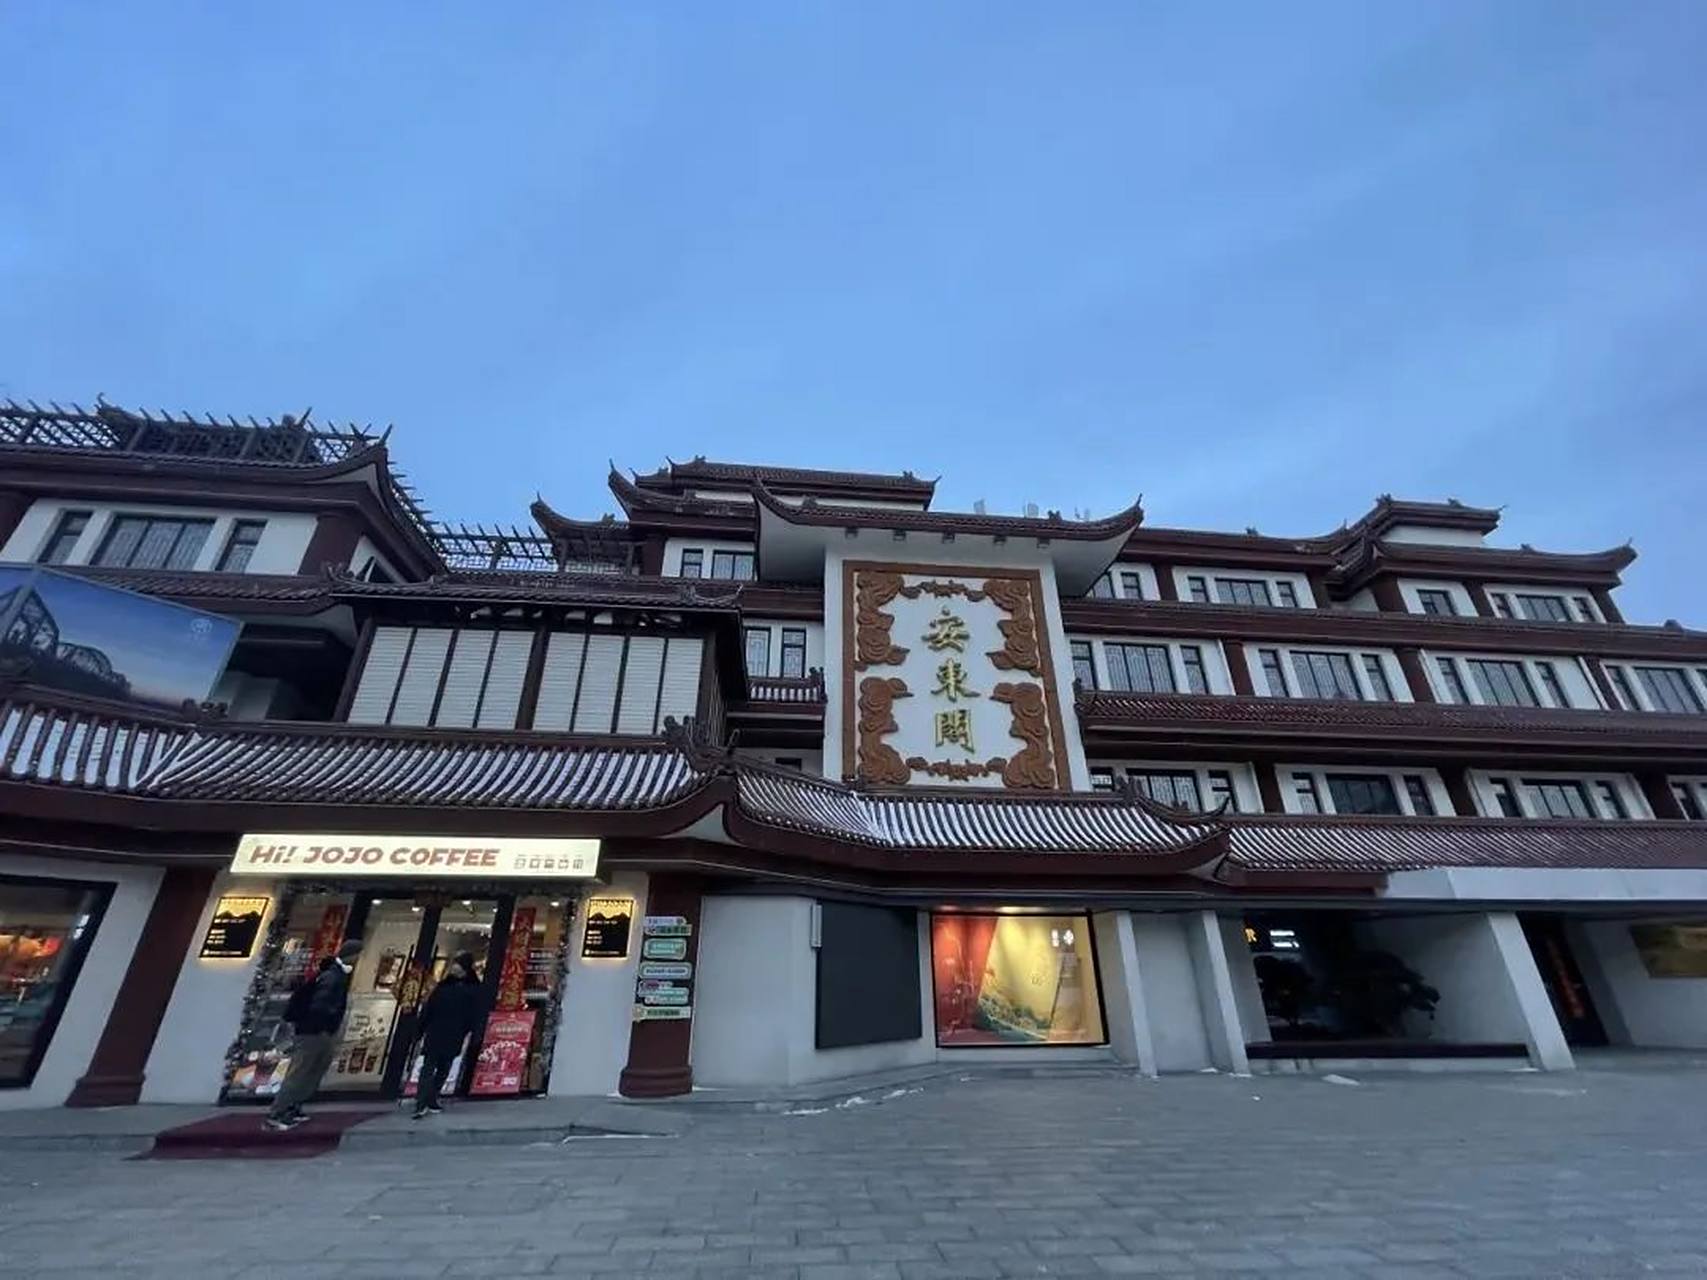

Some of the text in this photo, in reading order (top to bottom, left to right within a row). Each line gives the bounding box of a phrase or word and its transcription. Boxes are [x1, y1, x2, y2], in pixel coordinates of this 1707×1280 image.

[920, 605, 981, 754] 安東閣
[249, 845, 297, 864] Hi!
[302, 846, 384, 865] JOJO
[389, 847, 500, 867] COFFEE
